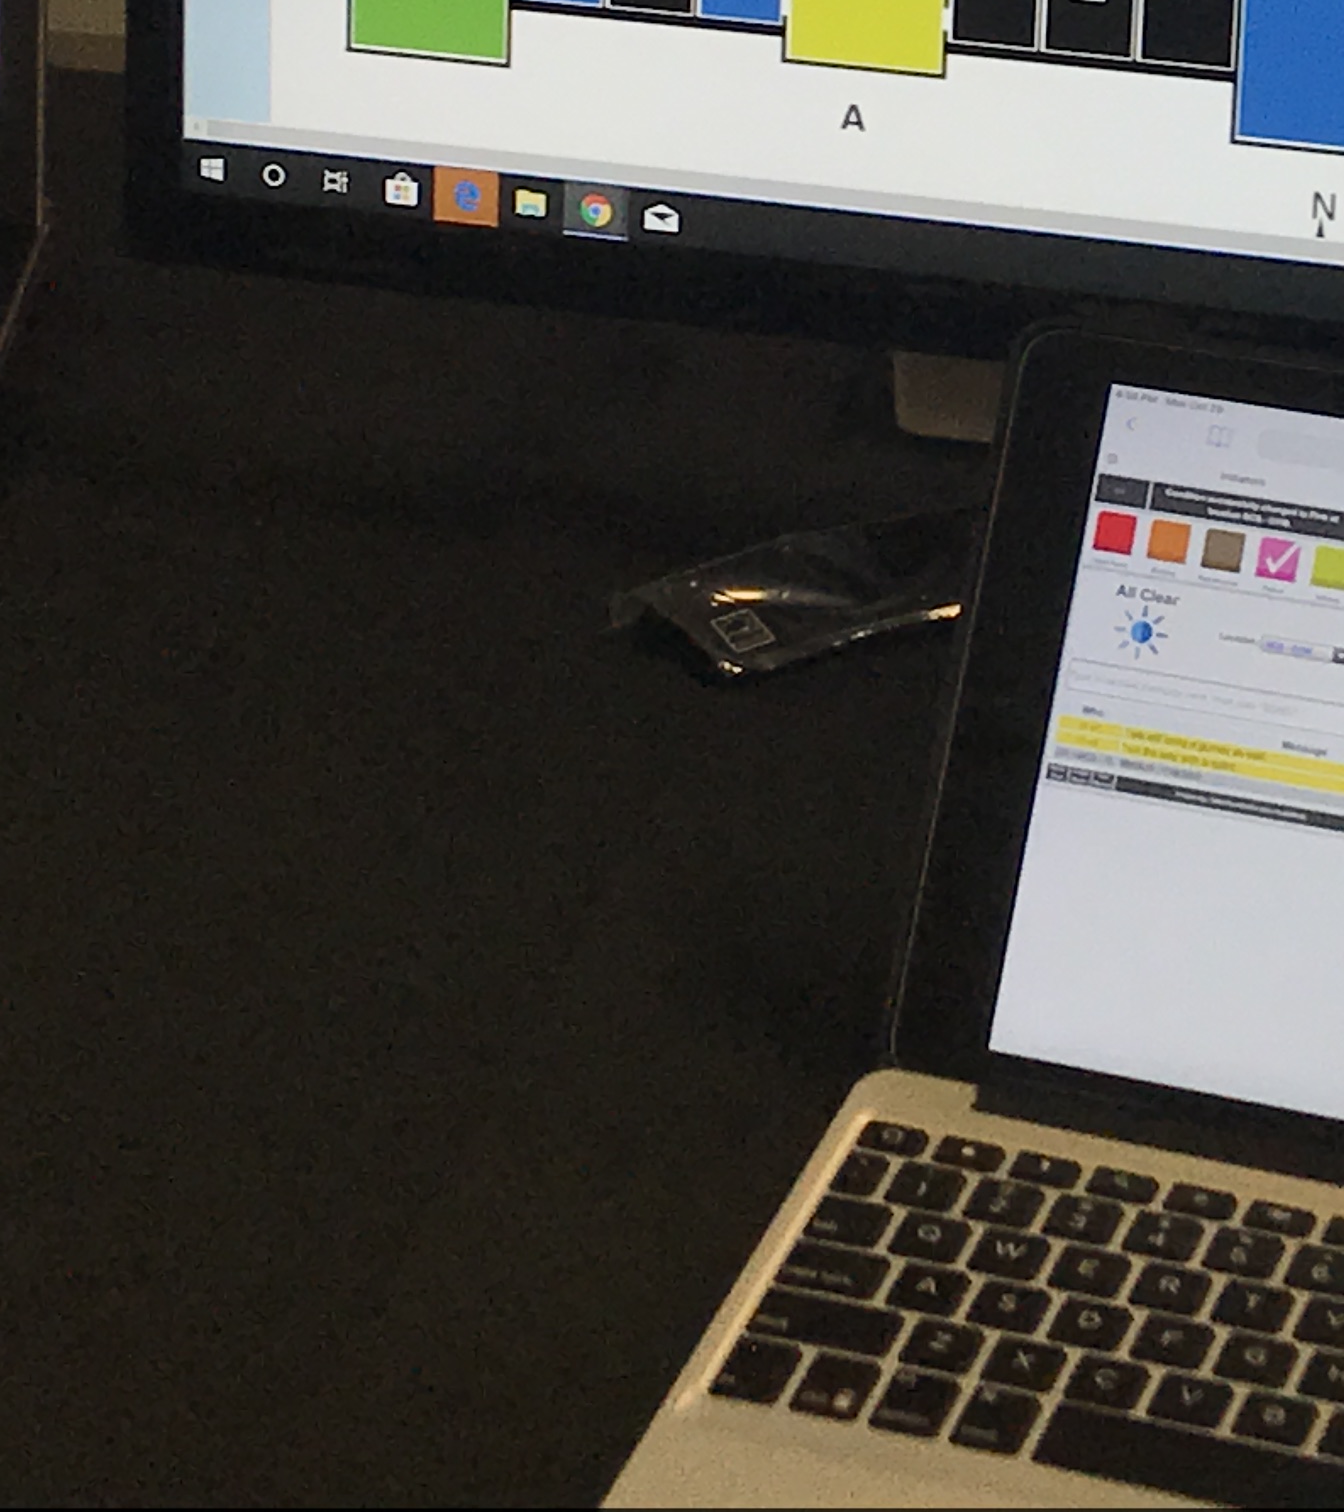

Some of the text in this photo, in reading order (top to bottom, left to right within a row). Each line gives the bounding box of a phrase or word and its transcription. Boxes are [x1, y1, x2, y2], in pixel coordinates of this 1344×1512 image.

[841, 104, 865, 132] A
[1312, 191, 1336, 221] N
[1115, 583, 1180, 605] All Clear
